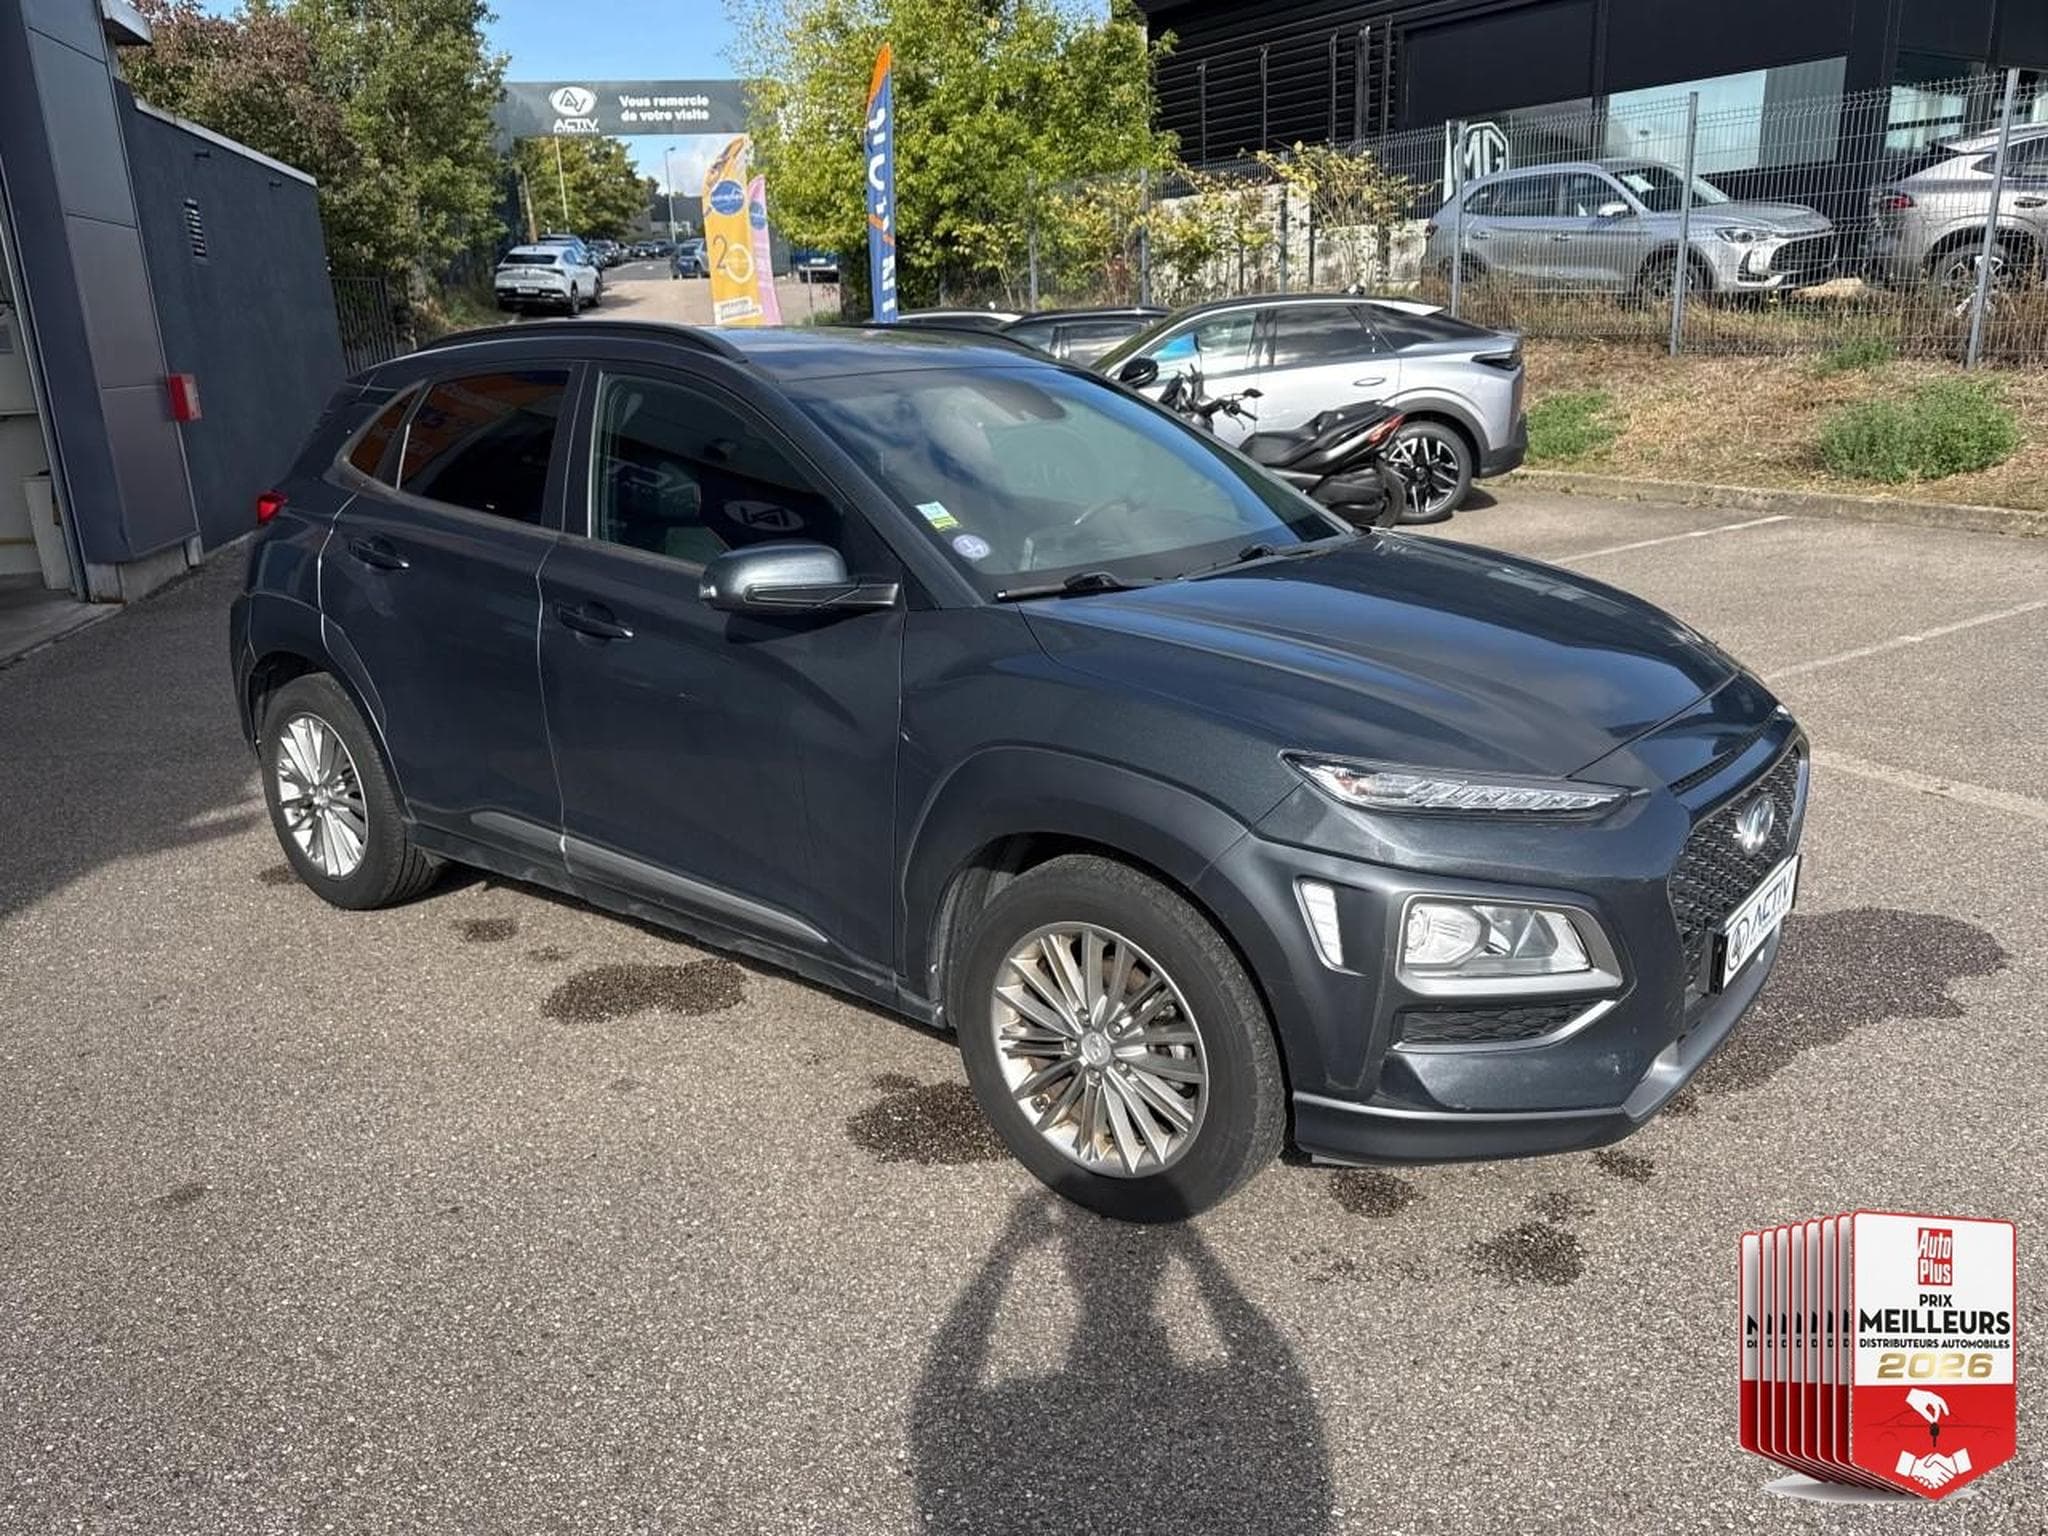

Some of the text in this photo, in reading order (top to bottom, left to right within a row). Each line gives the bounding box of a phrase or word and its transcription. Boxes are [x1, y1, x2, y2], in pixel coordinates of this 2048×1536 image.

[619, 94, 710, 107] Vous remercie
[621, 109, 710, 121] de votre visite
[553, 118, 599, 129] ACTIV
